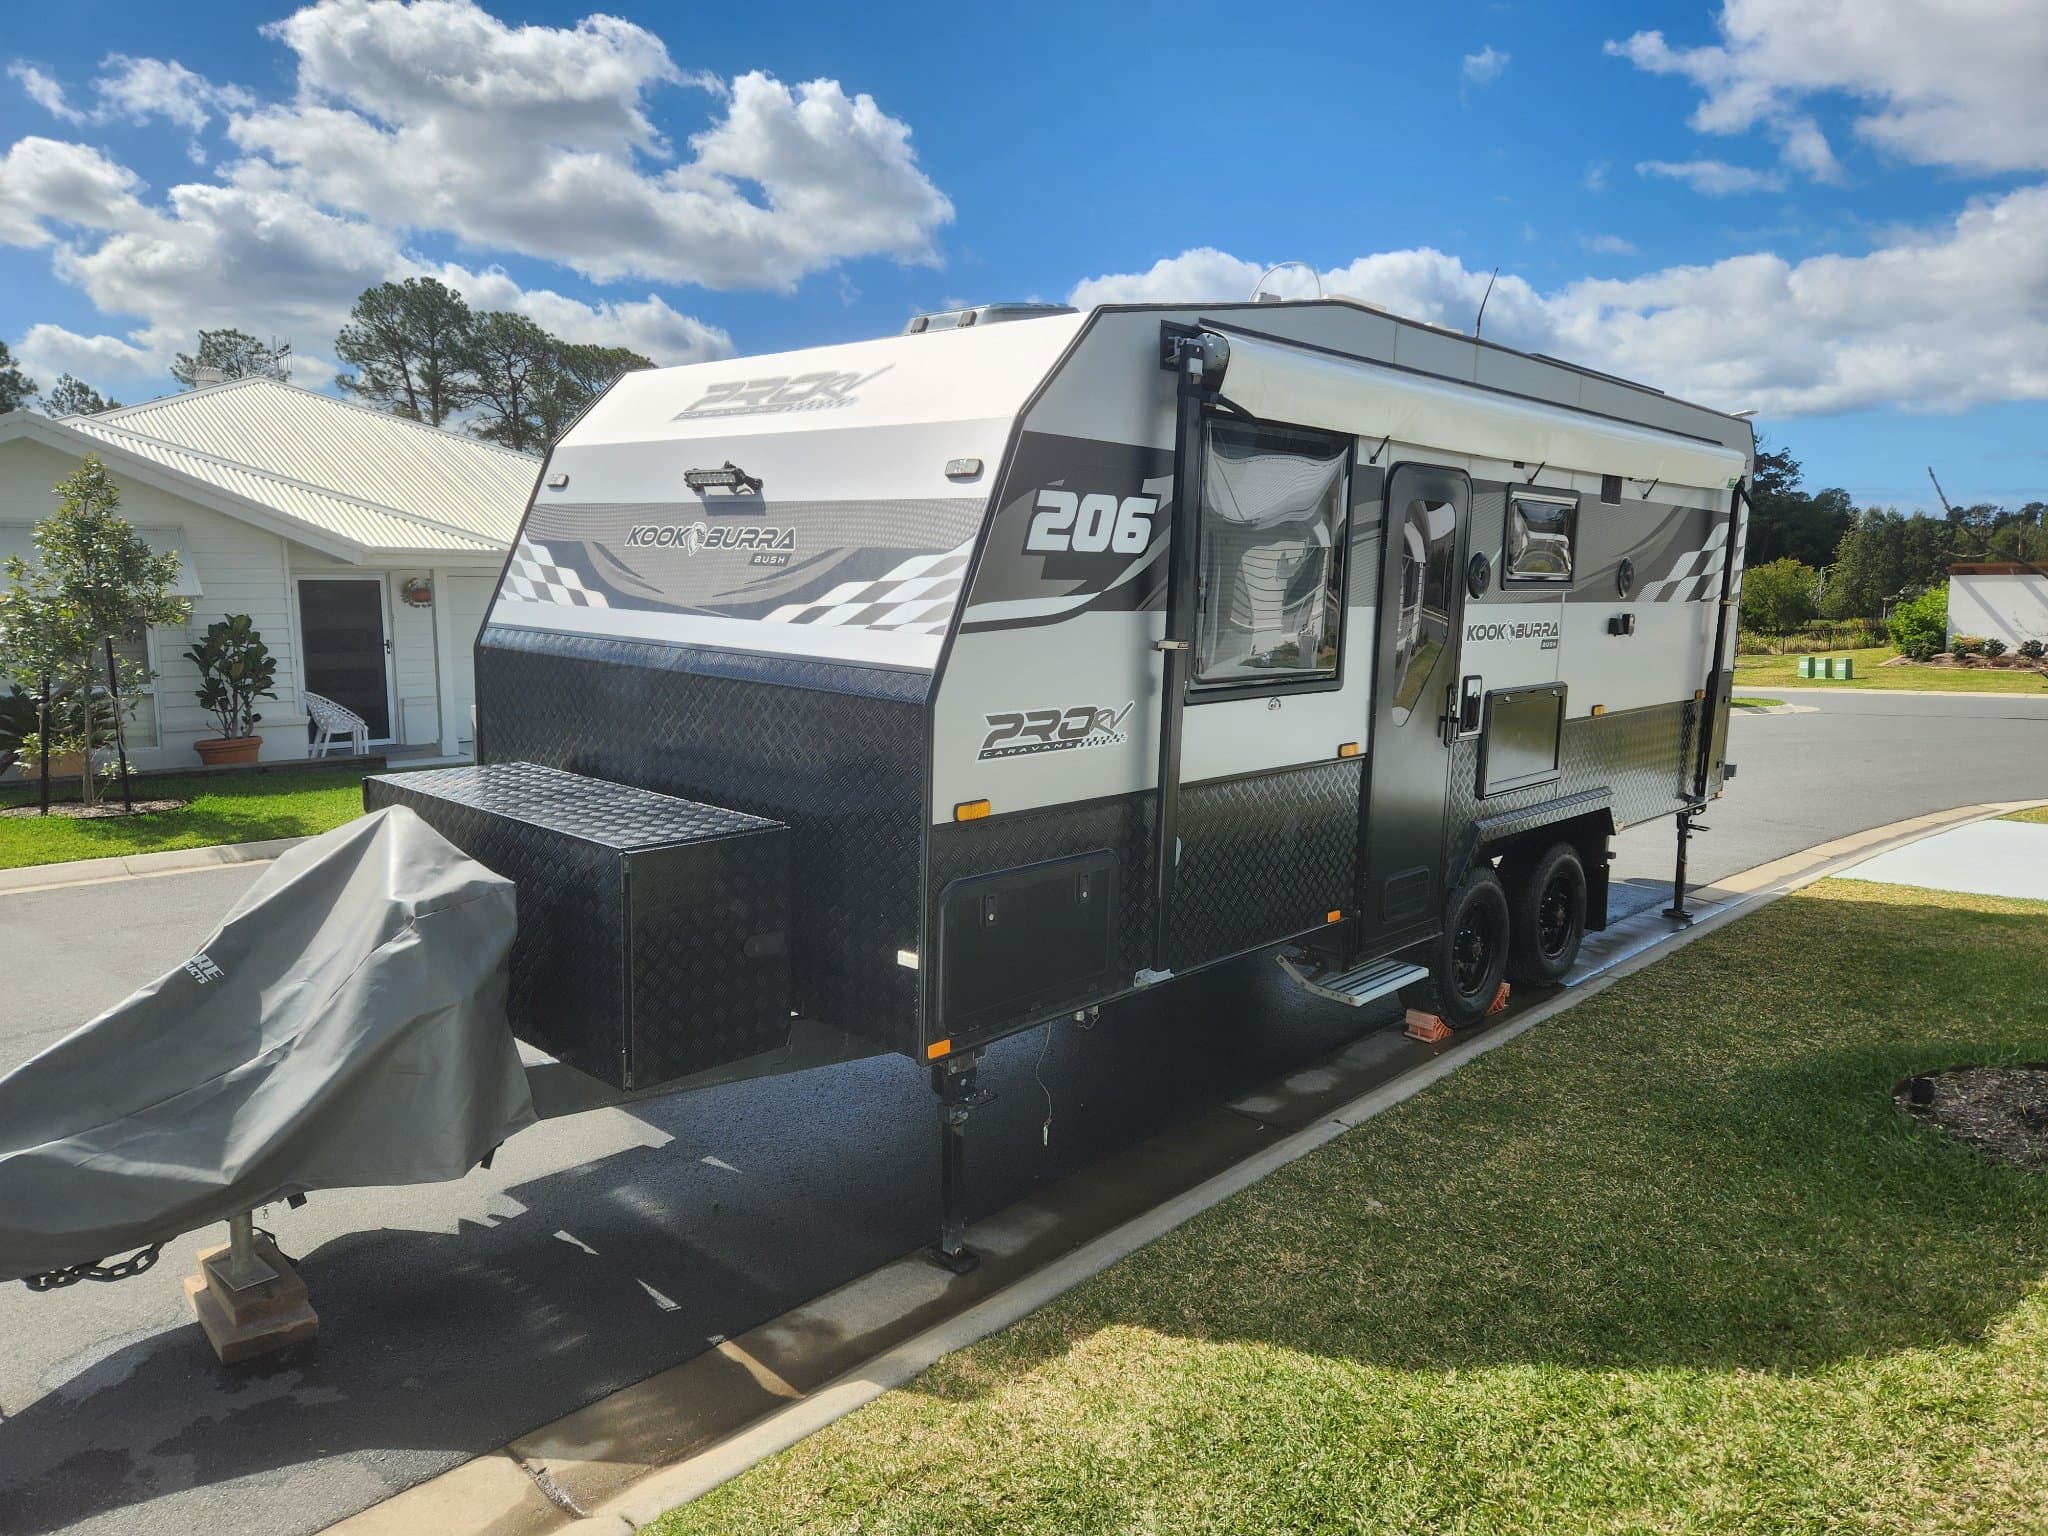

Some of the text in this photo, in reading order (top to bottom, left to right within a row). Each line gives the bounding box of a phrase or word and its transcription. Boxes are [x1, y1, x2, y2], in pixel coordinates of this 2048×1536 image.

[1026, 489, 1158, 554] 206
[753, 555, 786, 564] BUSH
[983, 741, 1073, 758] CARAVANS
[191, 953, 225, 980] RE
